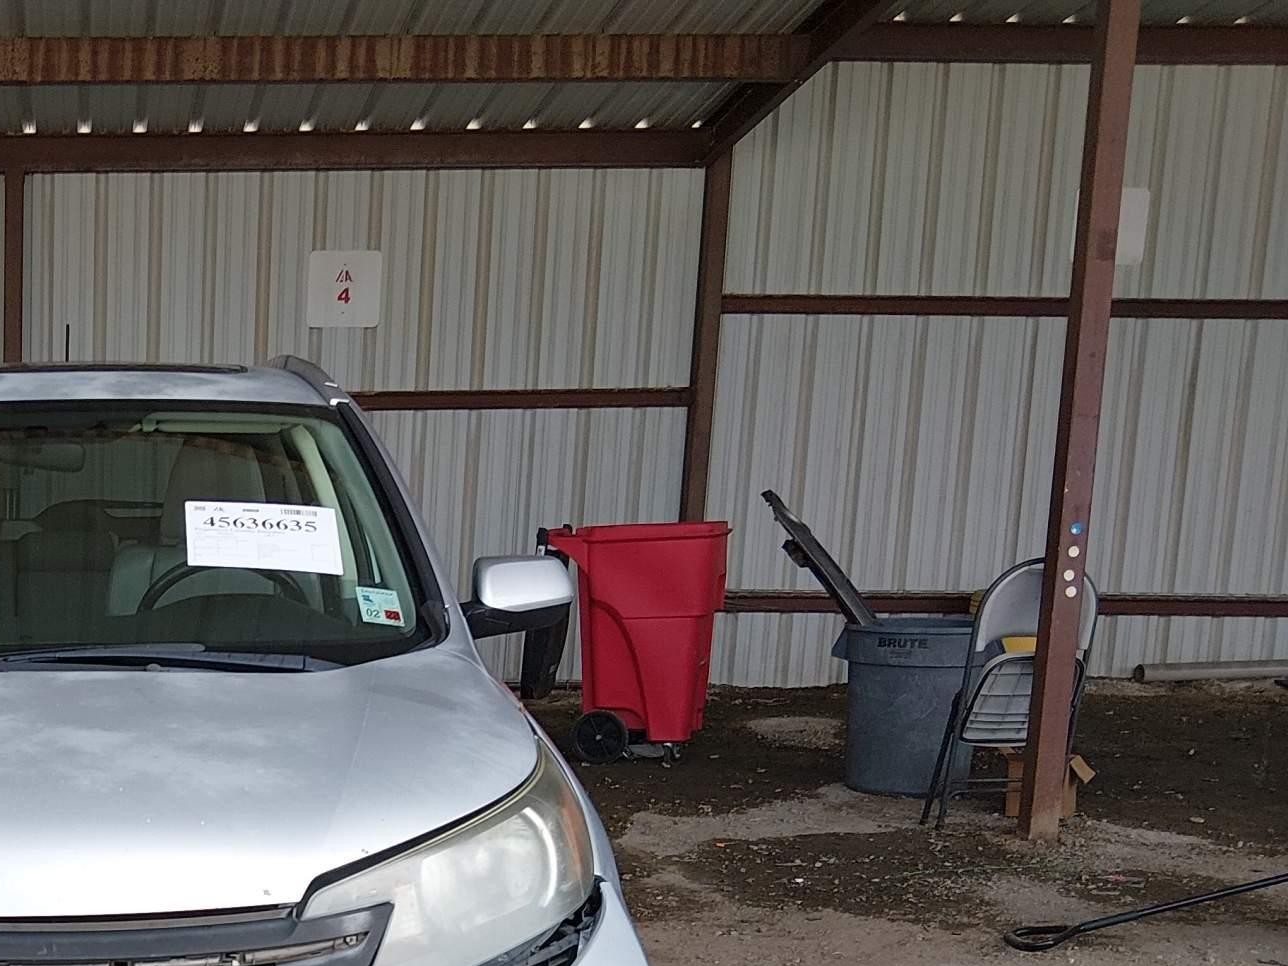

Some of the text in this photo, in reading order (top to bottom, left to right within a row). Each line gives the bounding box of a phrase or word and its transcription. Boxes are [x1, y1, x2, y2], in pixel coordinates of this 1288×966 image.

[337, 287, 351, 304] 4
[202, 516, 318, 533] 45636635
[366, 608, 381, 619] 02
[876, 637, 929, 649] BRUTE
